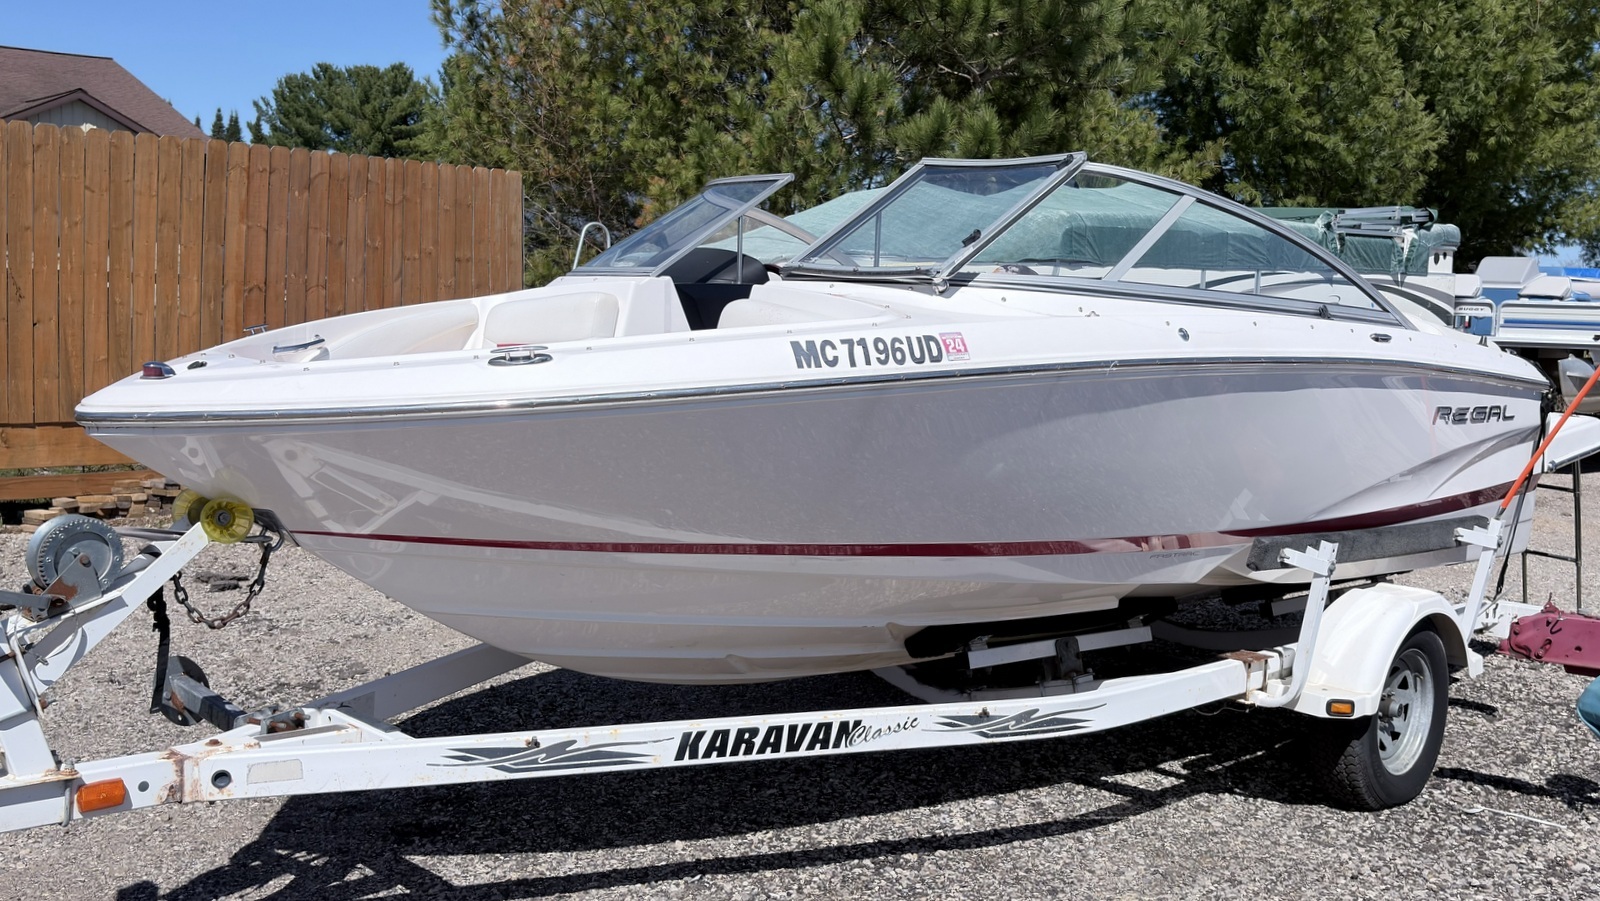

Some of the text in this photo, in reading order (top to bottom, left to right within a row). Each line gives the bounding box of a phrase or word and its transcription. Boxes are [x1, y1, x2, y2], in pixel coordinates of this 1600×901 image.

[945, 338, 965, 353] 24
[1432, 404, 1515, 426] REGAL
[674, 716, 920, 761] KARAVAN Classic
